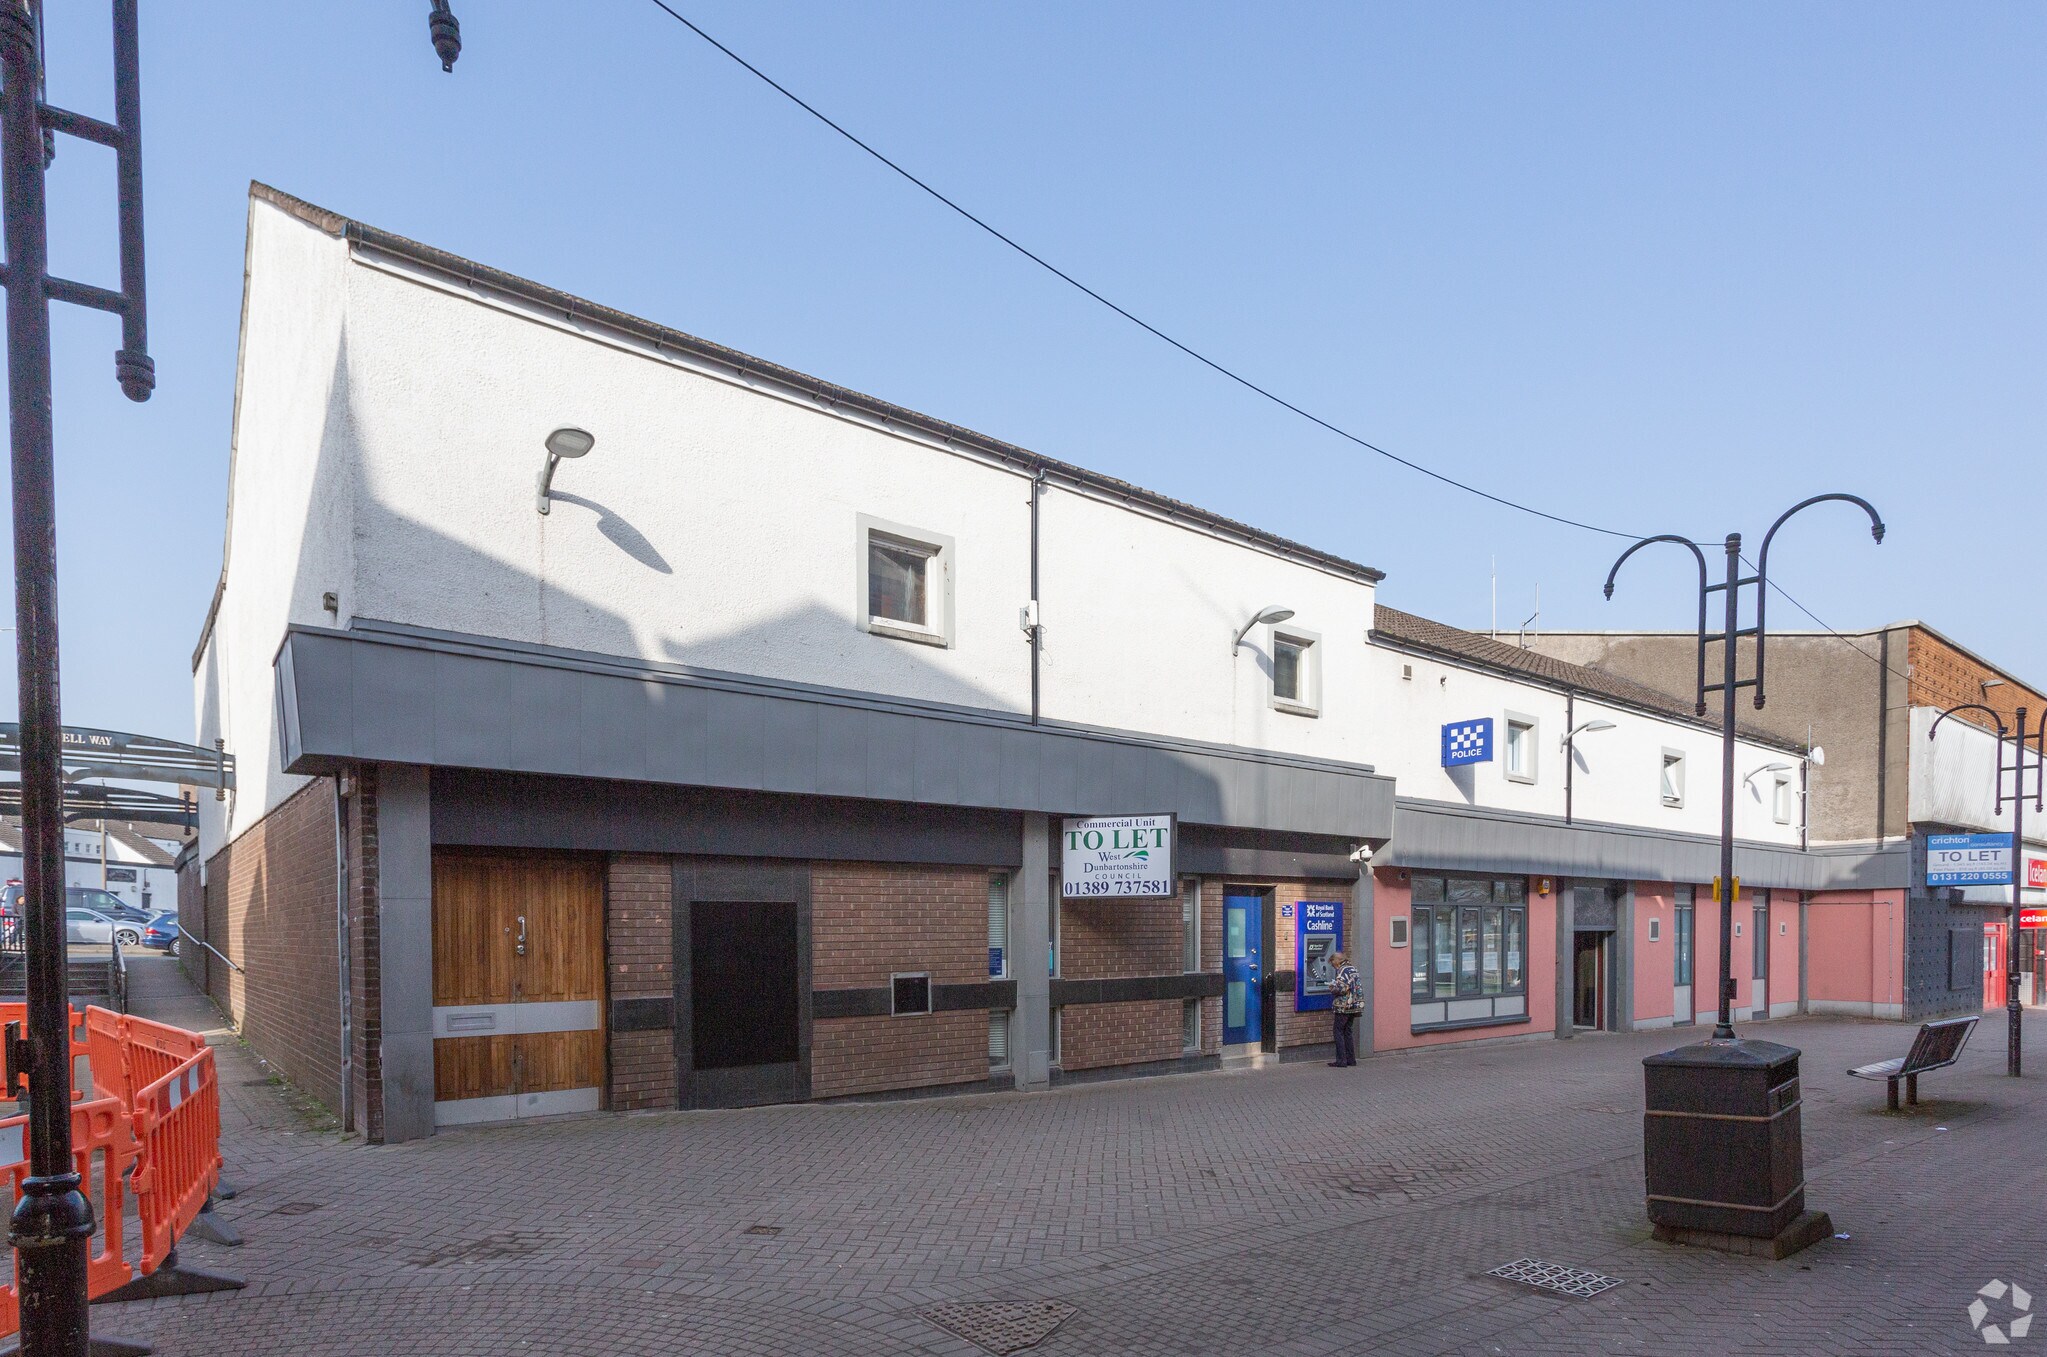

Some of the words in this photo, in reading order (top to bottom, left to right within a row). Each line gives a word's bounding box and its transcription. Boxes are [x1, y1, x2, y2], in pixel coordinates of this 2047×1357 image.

[62, 733, 86, 744] ELL
[89, 735, 112, 746] WAY
[1451, 748, 1483, 759] POLICE
[1076, 819, 1133, 829] Commercial
[1135, 818, 1156, 827] Unit
[1065, 830, 1104, 850] TO
[1111, 828, 1168, 849] LET
[1931, 837, 1970, 845] crichton
[1098, 851, 1121, 862] West
[1938, 851, 1962, 862] TO
[1968, 850, 2002, 862] LET
[1083, 862, 1148, 873] Dunbartonshire
[2029, 863, 2047, 883] Icelan
[1932, 873, 1958, 881] 0131
[1982, 872, 2008, 880] 0555
[1064, 881, 1110, 895] 01389
[1114, 880, 1169, 894] 737581
[2020, 914, 2047, 923] celan
[1306, 920, 1333, 931] Cashline
